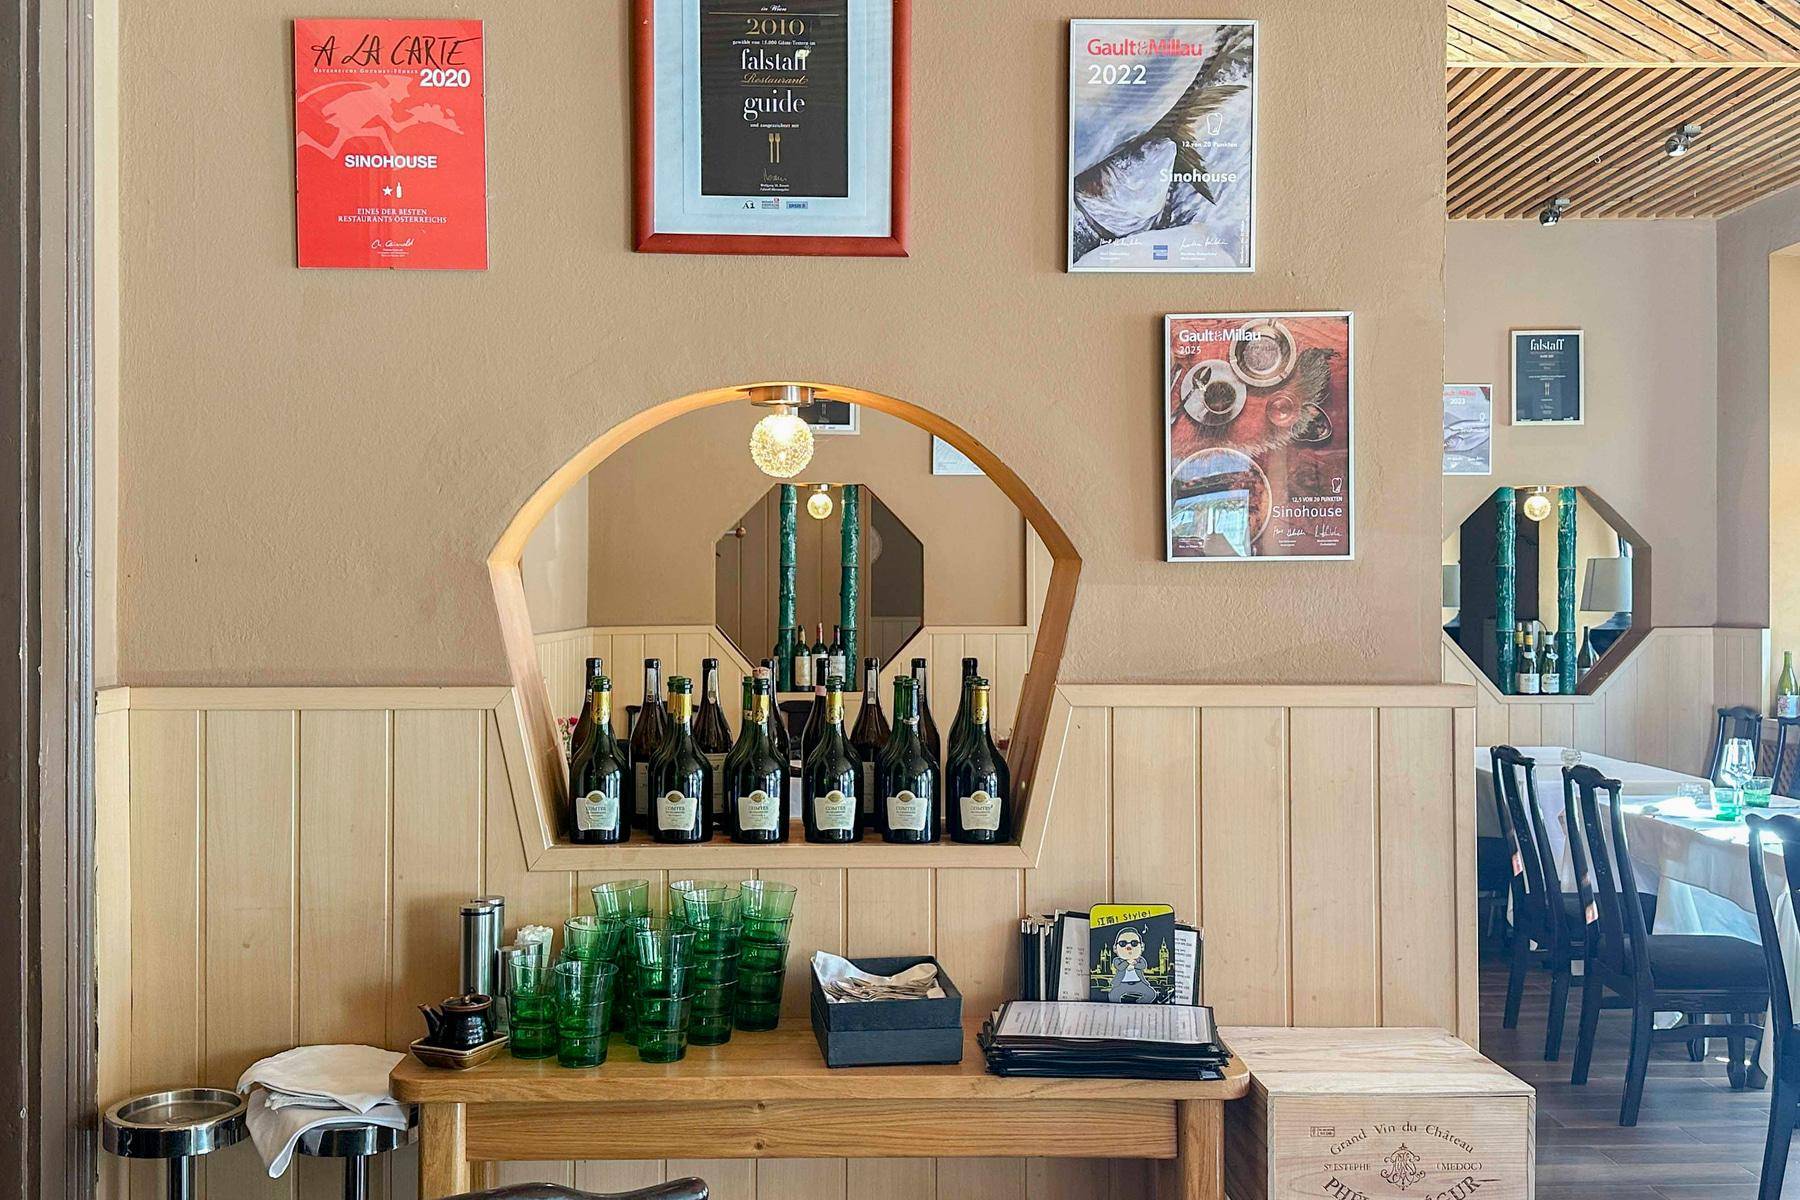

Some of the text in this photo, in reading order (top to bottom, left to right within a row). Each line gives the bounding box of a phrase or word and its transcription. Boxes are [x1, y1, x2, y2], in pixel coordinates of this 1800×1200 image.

[745, 19, 805, 35] 2010
[311, 34, 481, 70] A LA CARTE
[1087, 38, 1203, 57] Gault&Millau
[741, 48, 811, 71] falstaff
[420, 69, 471, 87] 2020
[741, 72, 809, 85] Restaurant
[1087, 64, 1148, 85] 2022
[743, 89, 805, 120] guide
[345, 155, 438, 169] SINOHOUSE
[1159, 168, 1237, 183] Sinohouse
[338, 215, 393, 223] RESTAURANTS
[381, 208, 397, 216] DER
[398, 208, 427, 216] BESTEN
[1179, 328, 1261, 343] Gault&Millau
[1179, 345, 1202, 355] 2025
[1530, 338, 1565, 350] falstaff
[1272, 505, 1343, 518] Sinohouse
[1122, 910, 1151, 921] Style!
[1330, 1128, 1367, 1155] Grand
[1373, 1124, 1395, 1135] Vin
[1401, 1121, 1417, 1132] du
[1425, 1124, 1474, 1154] Château
